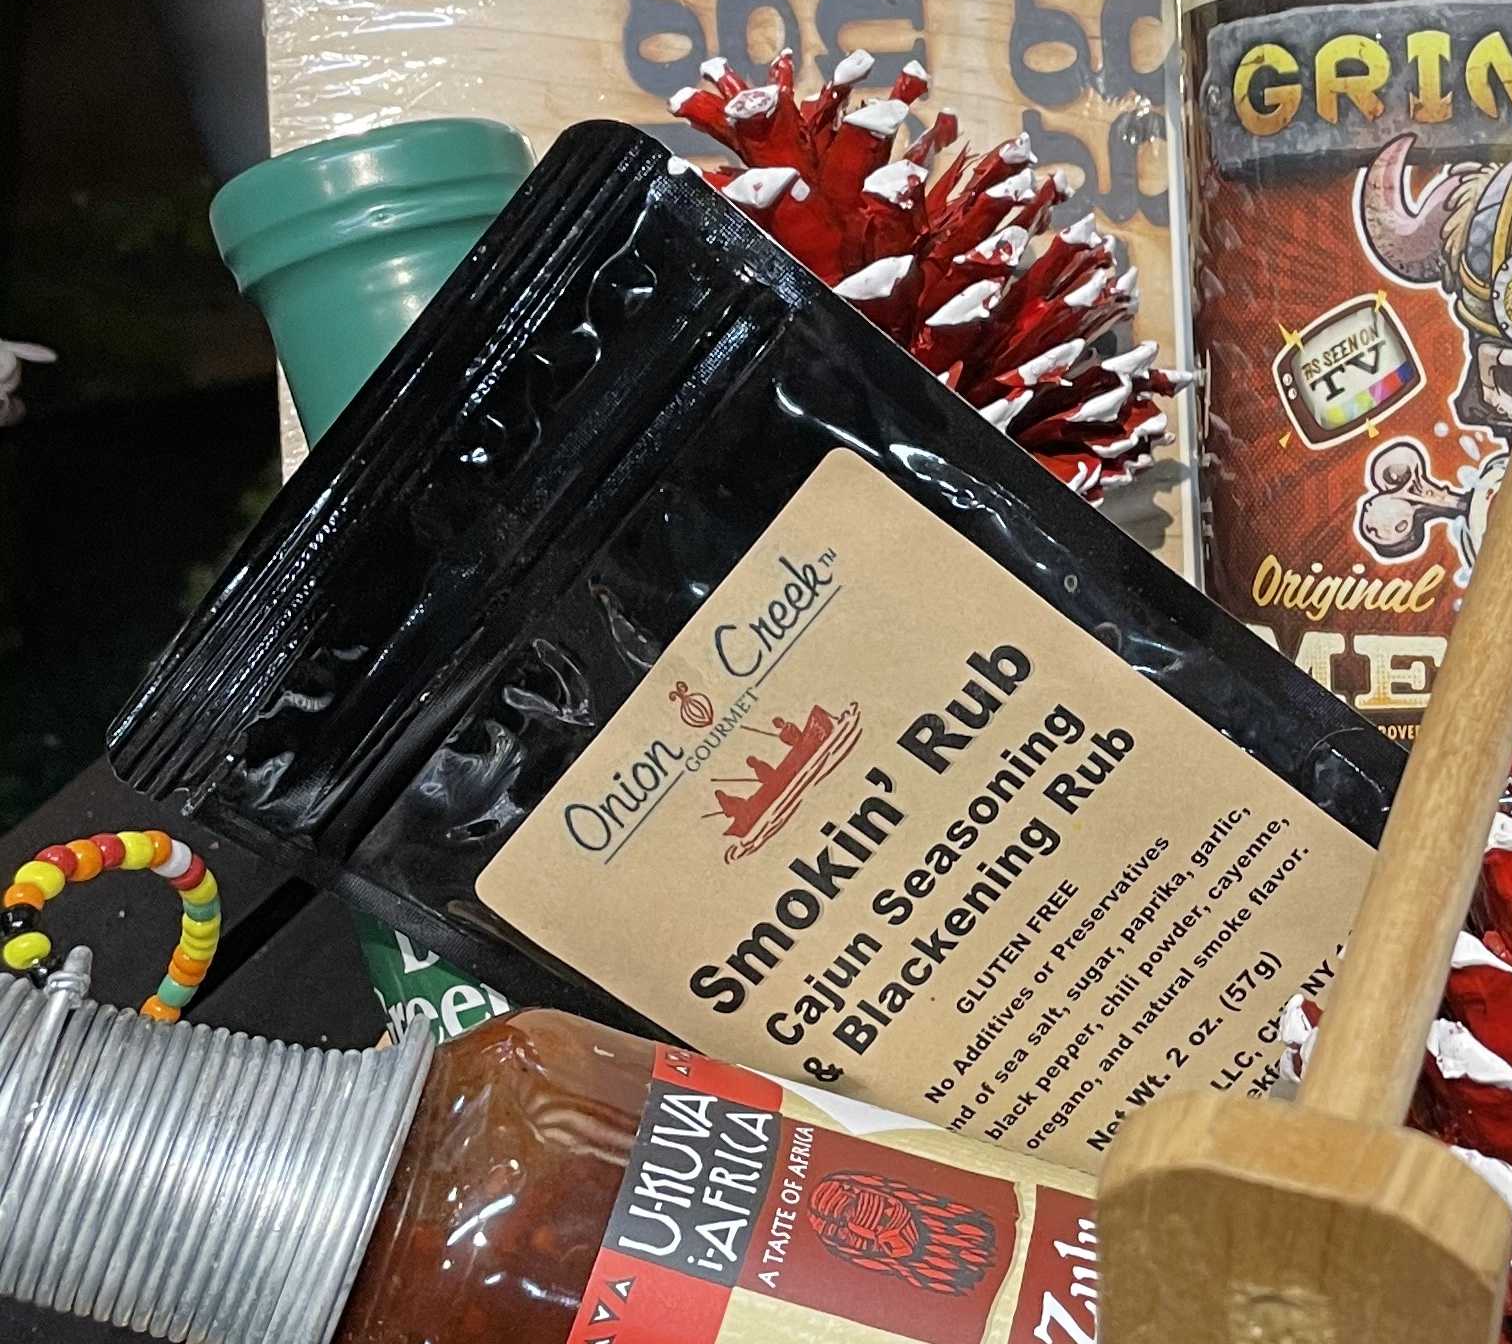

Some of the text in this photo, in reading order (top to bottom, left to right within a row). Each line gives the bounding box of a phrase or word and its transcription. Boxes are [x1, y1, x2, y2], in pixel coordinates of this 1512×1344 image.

[1301, 324, 1379, 379] AS SEEN ON
[1310, 340, 1386, 401] TV
[1250, 553, 1446, 623] Original
[563, 739, 683, 852] Onion
[713, 555, 833, 678] Creek
[683, 685, 759, 772] GOURMET
[688, 644, 1032, 1014] Smokin' Rub
[765, 702, 1086, 1046] Cajun Seasoning
[803, 727, 1135, 1083] & Blackening Rub
[923, 836, 1169, 1104] No Additives or Preservatives
[955, 878, 1079, 1014] GLUTEN FREE
[974, 1080, 996, 1105] of
[993, 1047, 1029, 1084] sea
[1026, 1005, 1071, 1046] salt,
[1065, 945, 1125, 1002] sugar,
[1119, 870, 1195, 944] paprika,
[1189, 806, 1251, 868] garlic,
[983, 817, 1290, 1141] black pepper, chili powder, cayenne,
[1025, 847, 1309, 1149] oregano, and natural smoke flavor.
[1209, 1049, 1264, 1091] LLC,
[1299, 958, 1335, 997] NY
[1124, 1072, 1171, 1107] Wt.
[1165, 1046, 1190, 1068] 2
[1187, 1016, 1224, 1046] oz.
[1218, 950, 1282, 1012] (57g)
[617, 1093, 718, 1257] U-KUVA
[757, 1126, 814, 1289] A TASTE OF AFRICA
